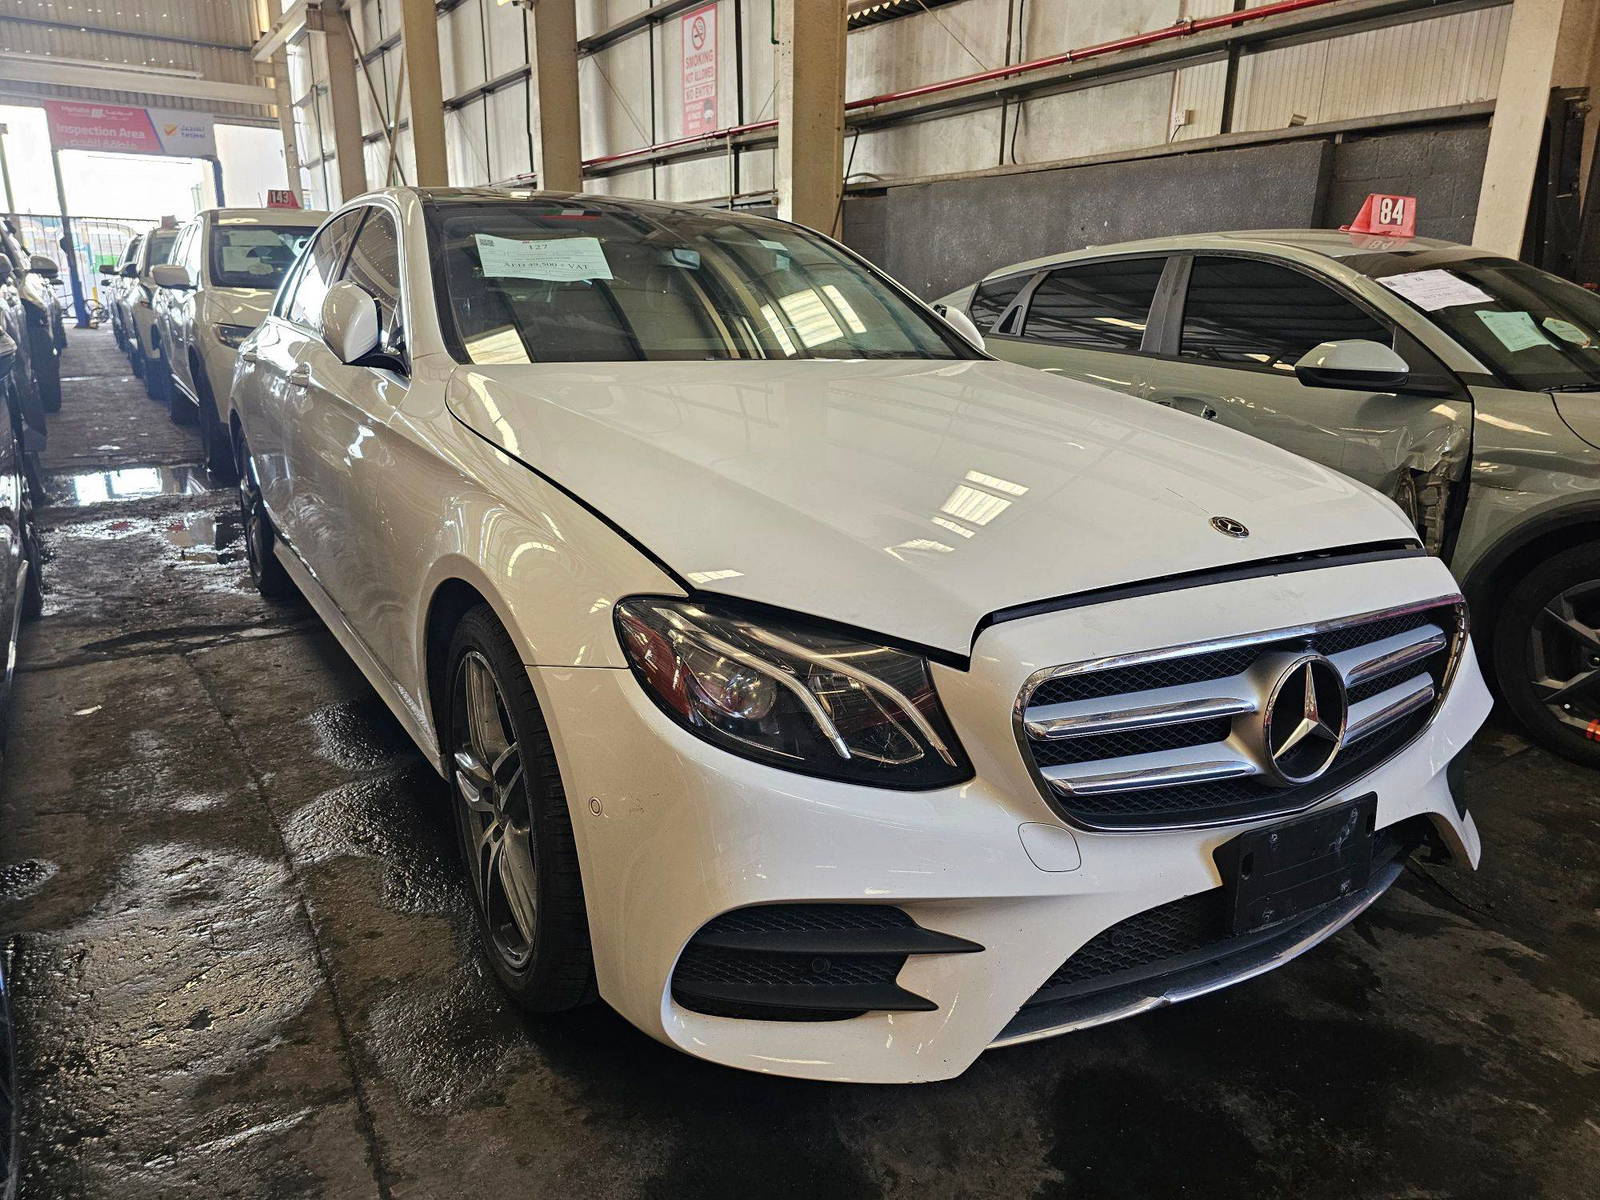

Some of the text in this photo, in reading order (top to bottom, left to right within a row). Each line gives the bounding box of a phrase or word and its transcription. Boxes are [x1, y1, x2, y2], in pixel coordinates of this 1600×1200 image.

[686, 49, 714, 70] SMOKING
[695, 83, 714, 98] ENTRY
[56, 123, 145, 139] Inspection Area
[271, 191, 289, 204] 143
[1380, 198, 1405, 225] 84
